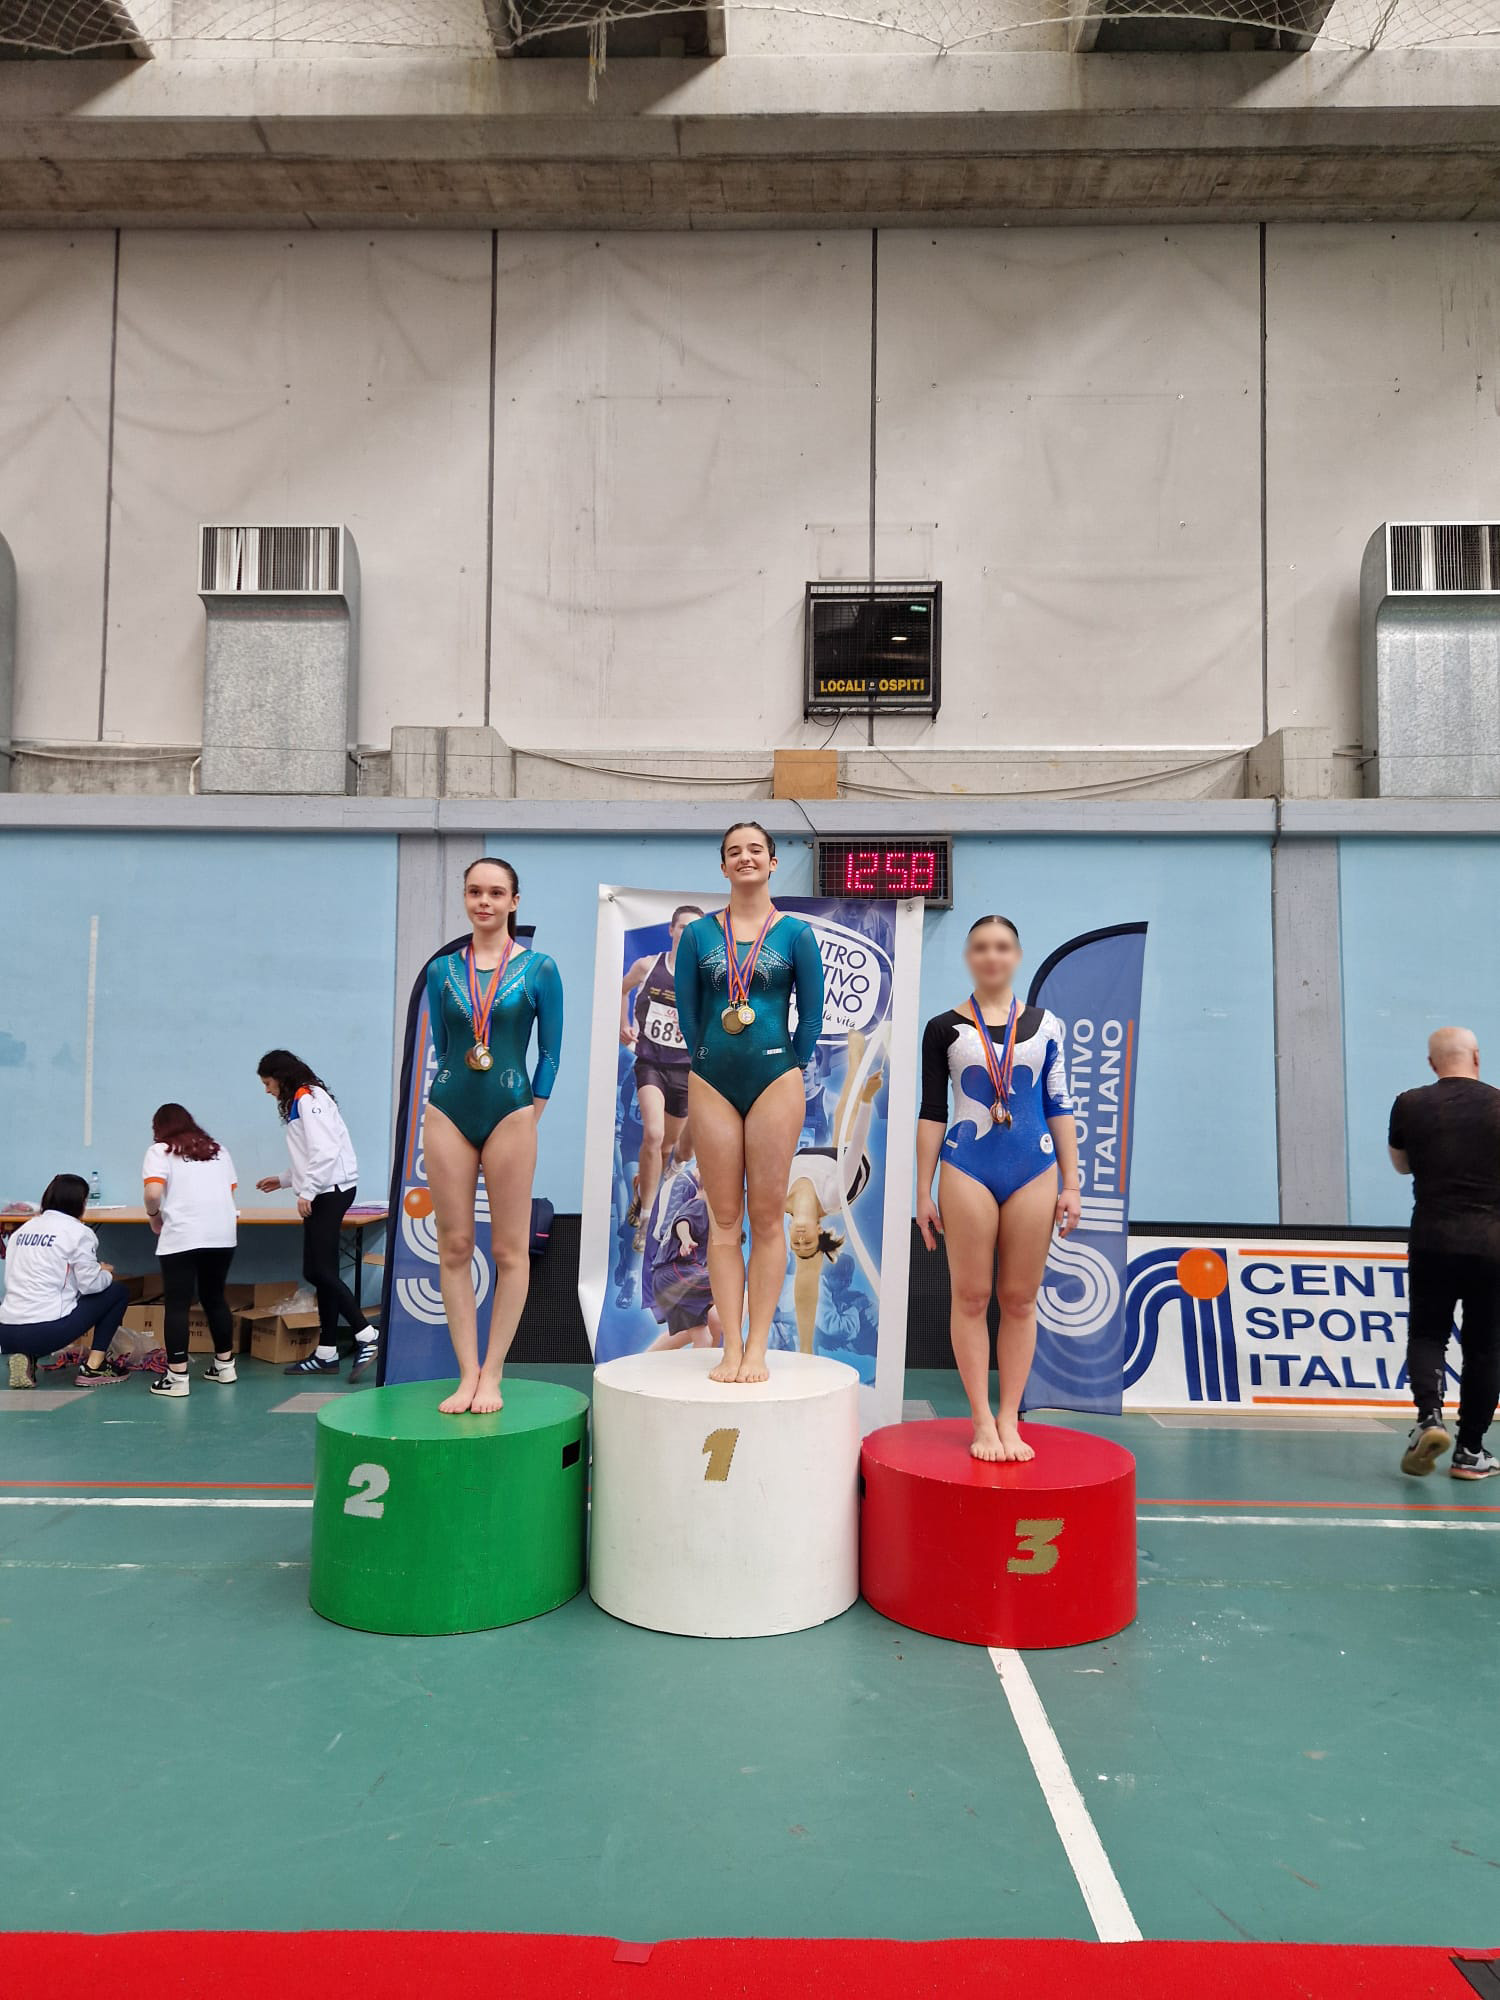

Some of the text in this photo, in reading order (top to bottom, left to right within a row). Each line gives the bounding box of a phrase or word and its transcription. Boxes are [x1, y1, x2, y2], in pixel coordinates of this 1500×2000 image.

[820, 679, 925, 693] LOCALI OSPITI
[1094, 1019, 1123, 1192] ITALIANO
[16, 1233, 56, 1247] GIUDICE
[702, 1427, 740, 1482] 1
[343, 1463, 391, 1519] 2
[1006, 1518, 1064, 1574] 3
